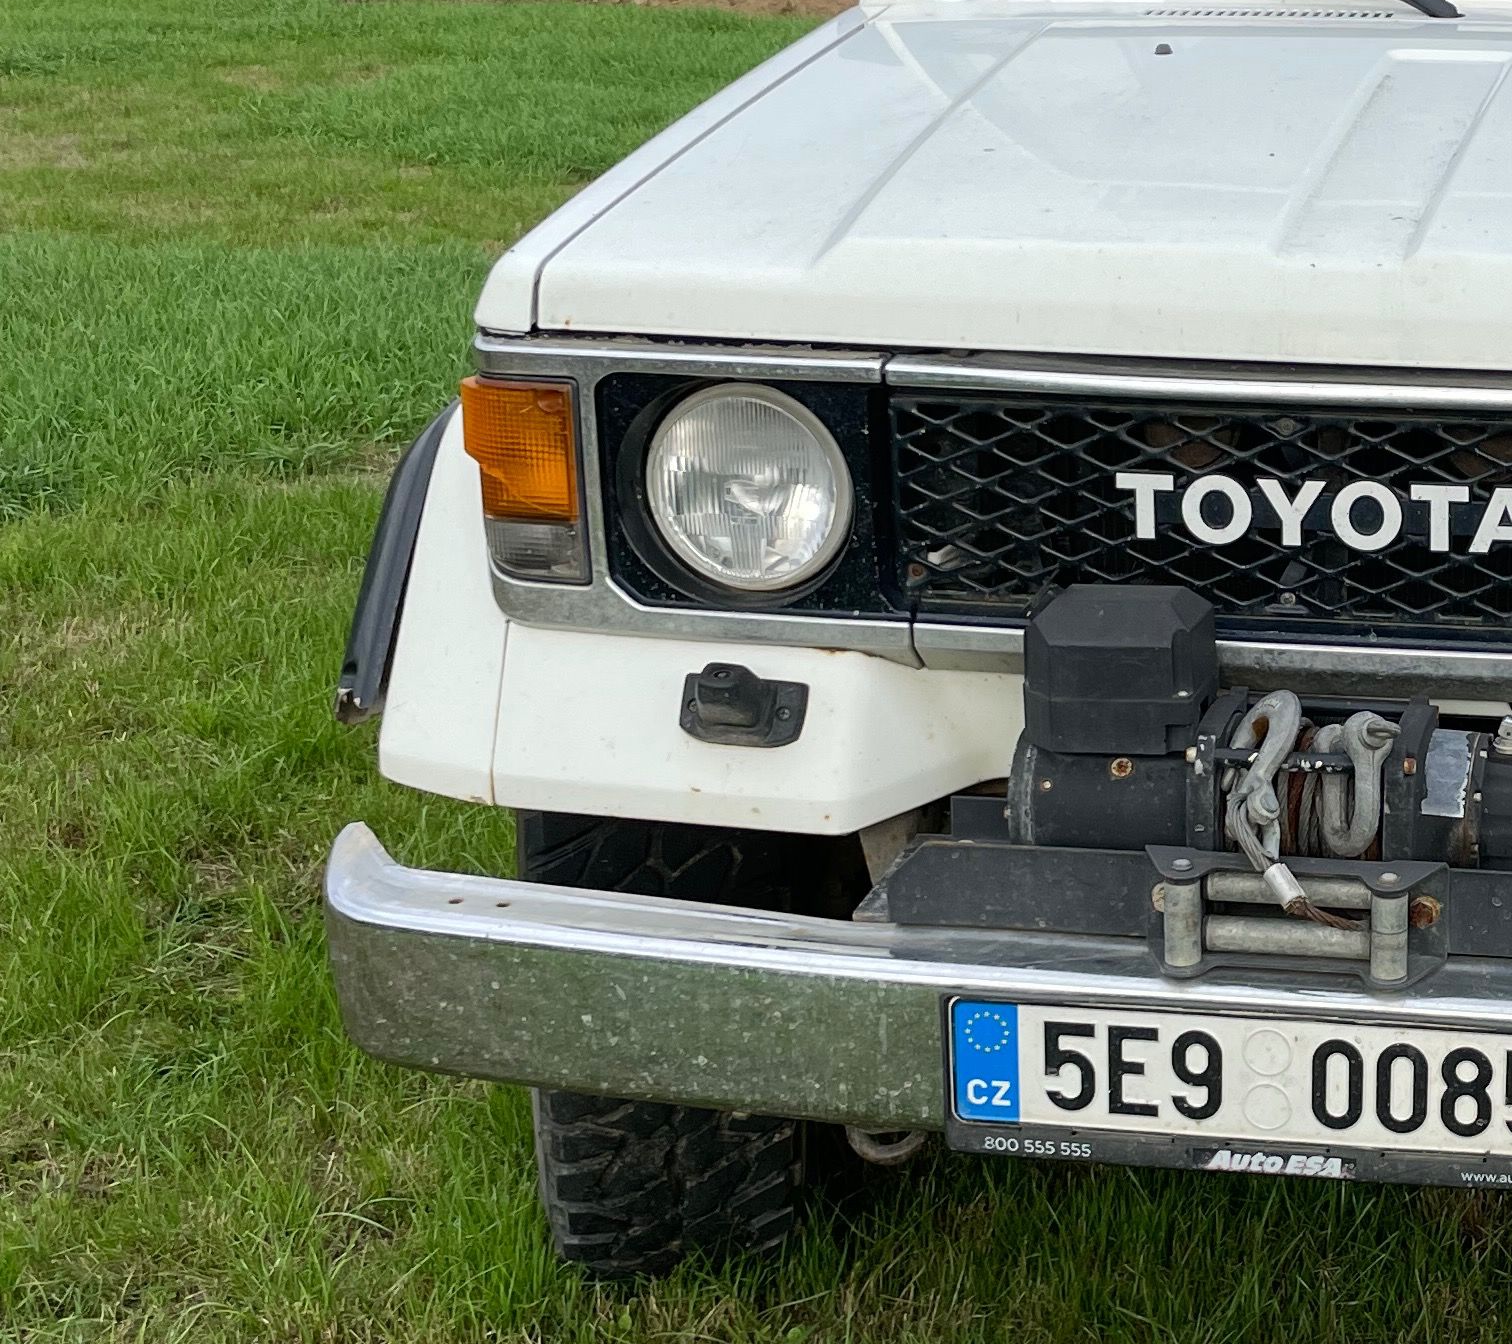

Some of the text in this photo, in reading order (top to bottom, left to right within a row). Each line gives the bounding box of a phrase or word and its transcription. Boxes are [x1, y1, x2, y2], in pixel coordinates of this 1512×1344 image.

[1043, 1021, 1224, 1120] 5E9
[966, 1078, 1011, 1107] CZ
[984, 1136, 1092, 1158] 800 555 555
[1207, 1149, 1343, 1177] Auto ESA
